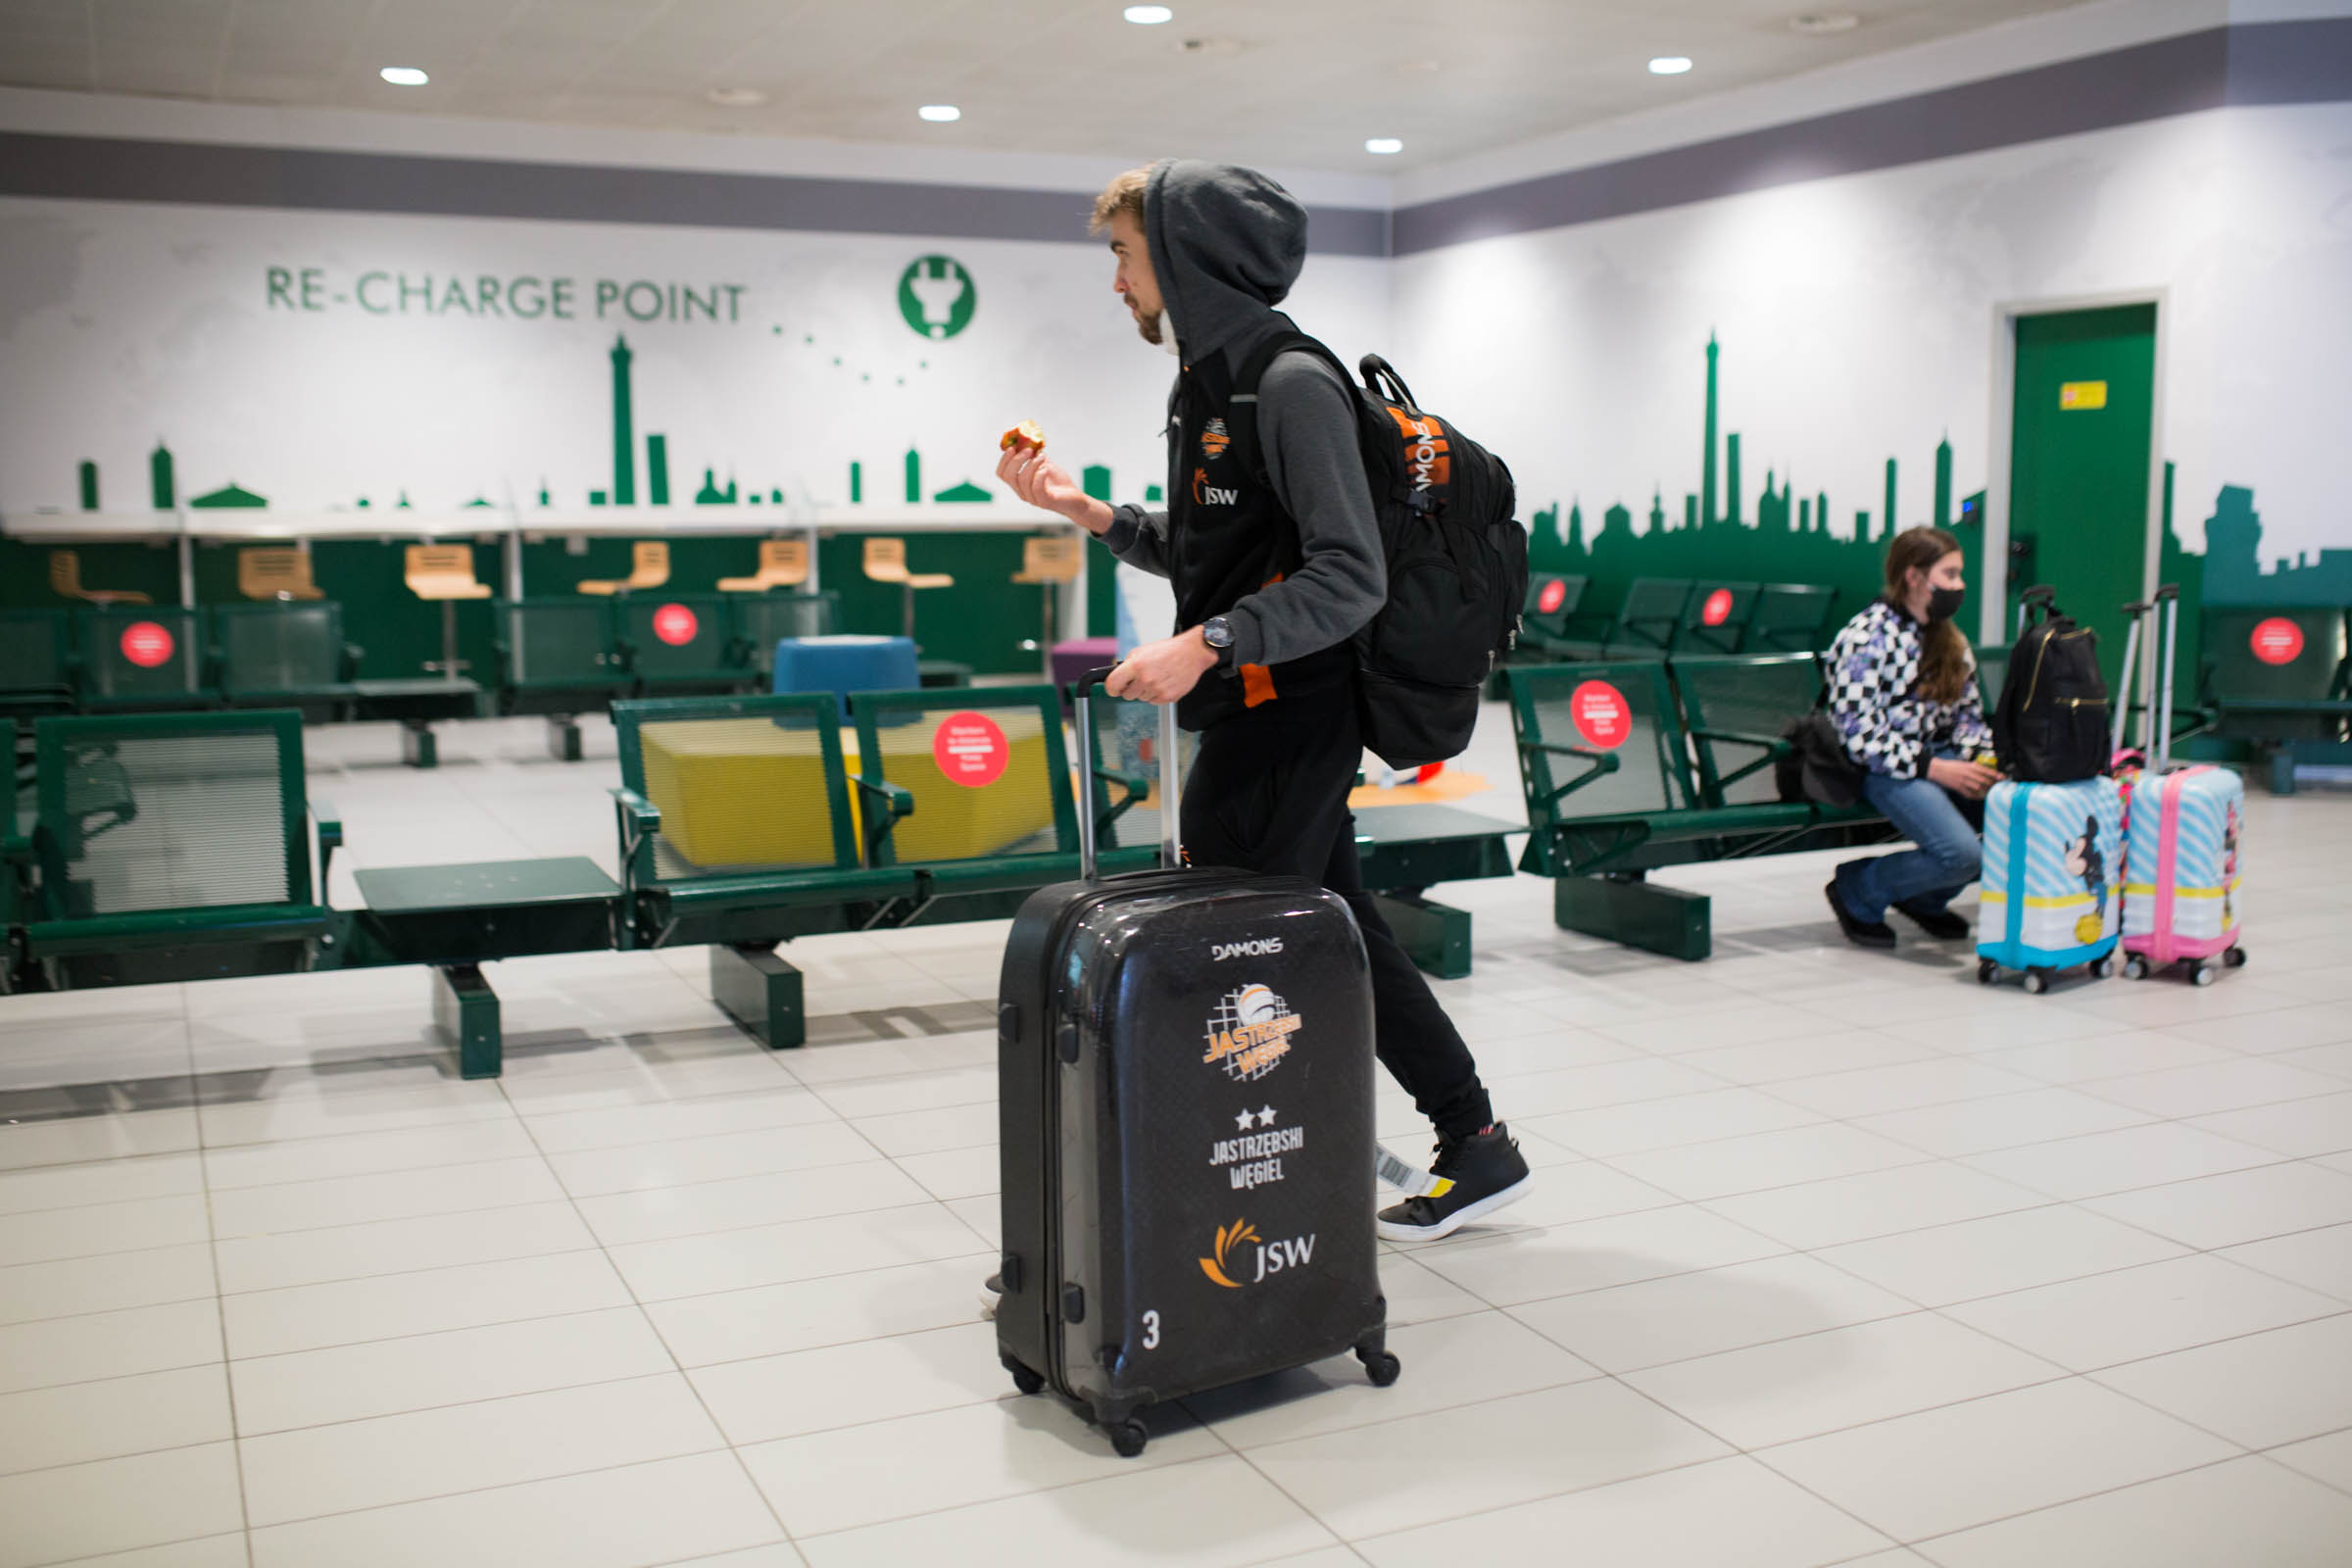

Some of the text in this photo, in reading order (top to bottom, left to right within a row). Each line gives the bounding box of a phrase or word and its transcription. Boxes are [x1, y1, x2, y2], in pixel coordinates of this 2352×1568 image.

[266, 267, 747, 322] RE-CHARGE POINT
[1411, 421, 1436, 492] AMONS
[1211, 937, 1284, 961] DAMONS
[1230, 1158, 1285, 1190] WĘGIEL
[1252, 1233, 1316, 1283] JSW
[1142, 1309, 1160, 1350] 3
